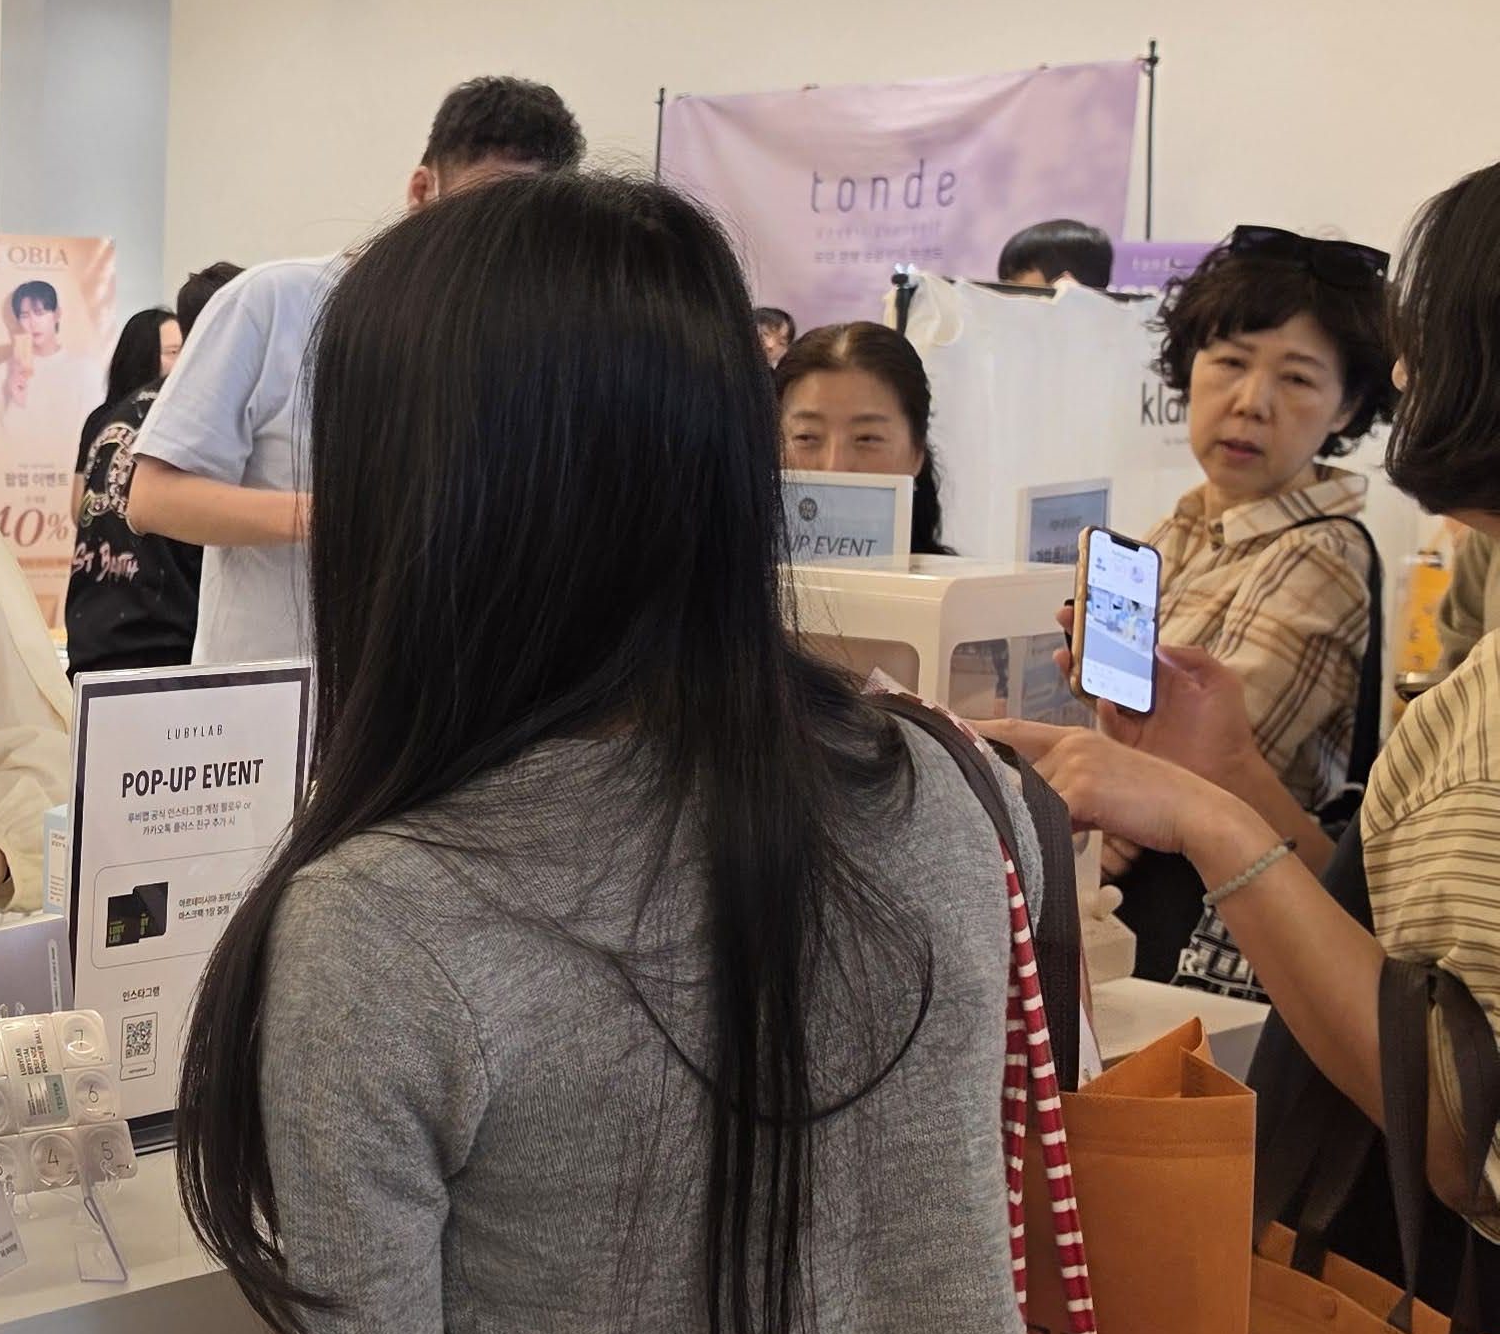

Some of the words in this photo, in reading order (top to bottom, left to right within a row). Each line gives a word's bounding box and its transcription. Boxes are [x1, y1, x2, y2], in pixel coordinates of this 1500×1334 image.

[811, 158, 955, 213] tonde
[7, 245, 69, 266] OBIA
[31, 471, 69, 487] 이벤트
[813, 536, 879, 558] EVENT
[167, 724, 224, 740] LUBYLAB
[121, 765, 197, 798] POP-UP
[202, 759, 264, 789] EVENT
[150, 809, 165, 821] 공식
[167, 804, 203, 819] 인스타그램
[221, 801, 241, 813] 팔로우
[142, 822, 171, 836] 카카오톡
[173, 820, 195, 833] 플러스
[196, 819, 211, 831] 친구
[212, 818, 227, 829] 추가
[228, 817, 236, 827] 시
[122, 986, 160, 1002] 인스타그램
[75, 1029, 85, 1049] 7
[88, 1084, 99, 1104] 6
[47, 1148, 59, 1166] 4
[101, 1141, 113, 1160] 5
